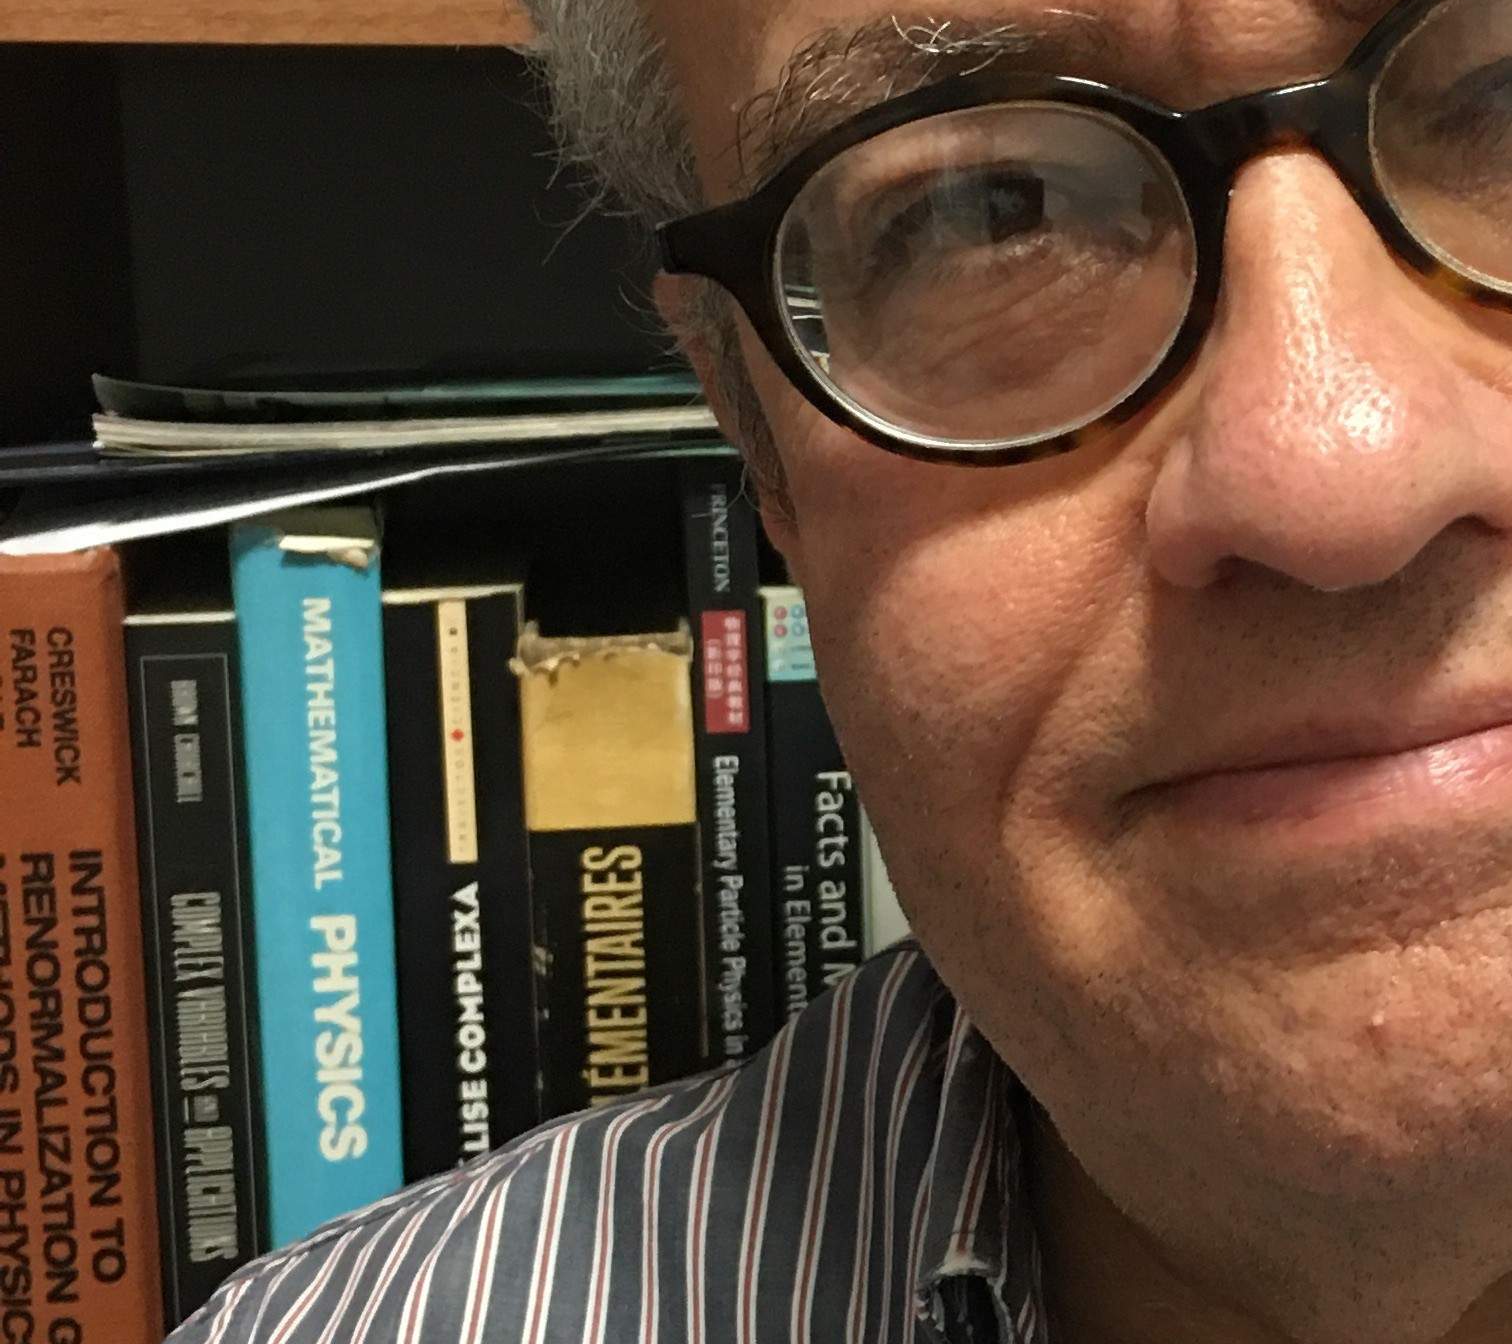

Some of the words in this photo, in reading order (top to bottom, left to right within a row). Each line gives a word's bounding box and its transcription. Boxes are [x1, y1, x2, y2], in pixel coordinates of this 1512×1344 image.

[10, 628, 42, 748] FARACH
[47, 626, 82, 786] CRESWICK
[302, 596, 344, 891] MATHEMATICAL
[712, 755, 741, 870] Elementary
[814, 771, 852, 868] Facts
[717, 874, 745, 952] Particle
[784, 865, 810, 892] in
[817, 879, 858, 950] and
[449, 881, 488, 1074] COMPLEXA
[581, 844, 649, 1098] ÉMENTAIRES
[717, 956, 748, 1031] Physics
[783, 899, 813, 1016] Element
[20, 853, 80, 1304] RENORMALIZATION
[69, 849, 123, 1224] INTRODUCTION
[310, 914, 368, 1163] PHYSICS
[459, 1079, 490, 1152] LISE
[90, 1234, 127, 1284] TO
